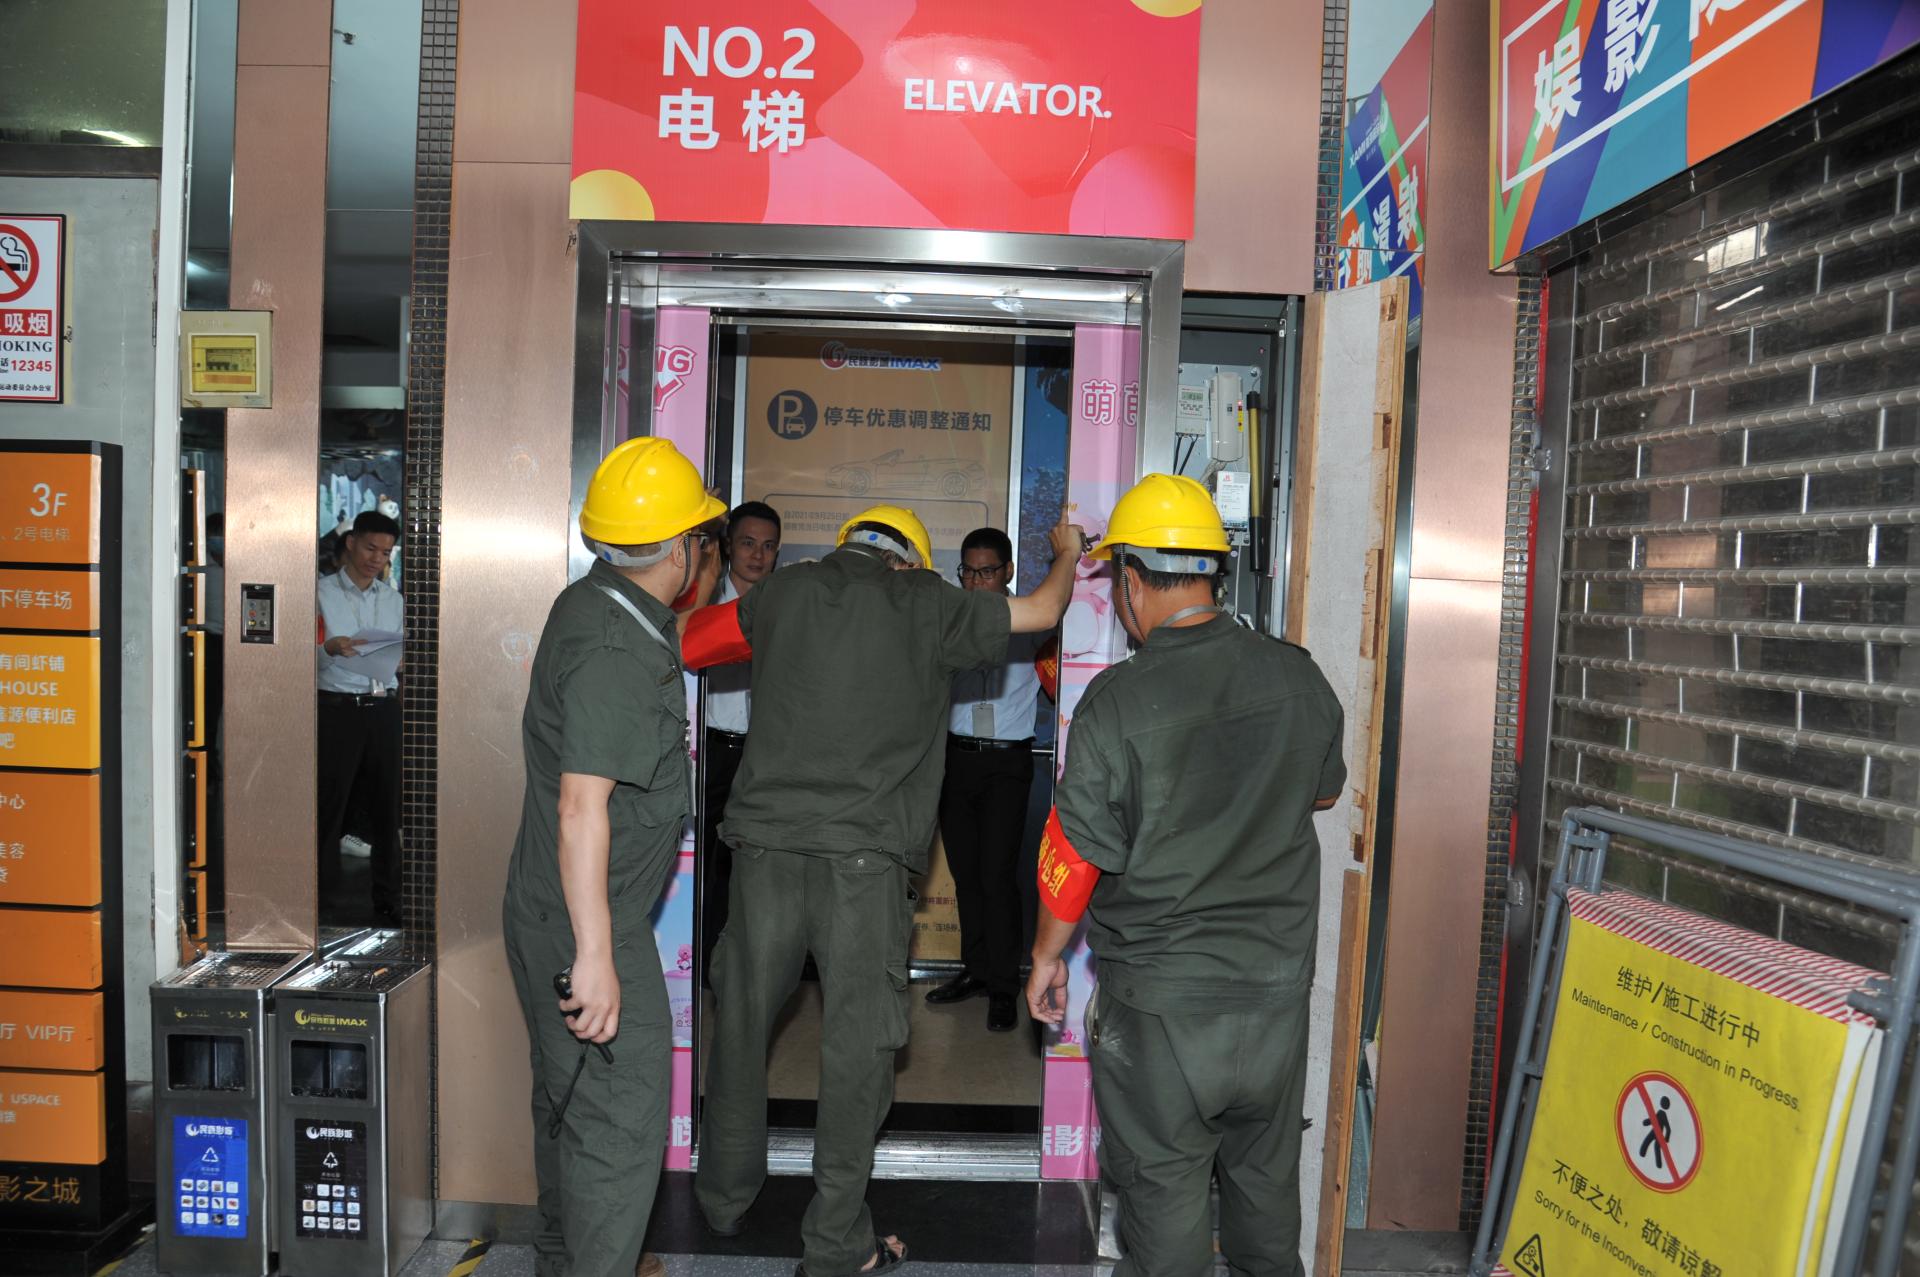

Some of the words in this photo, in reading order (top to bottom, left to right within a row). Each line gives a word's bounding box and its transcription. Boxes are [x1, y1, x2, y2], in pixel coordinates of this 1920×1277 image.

[662, 26, 816, 79] NO.2
[904, 78, 1112, 119] ELEVATOR.
[658, 87, 806, 153] 电梯
[0, 312, 49, 334] 吸烟
[11, 360, 53, 372] 12345
[823, 406, 992, 432] 停车优惠调整通知
[1082, 380, 1117, 425] 萌
[30, 483, 68, 517] 3F
[0, 681, 59, 696] HOUSE
[1616, 966, 1760, 1049] 维护/施工进行中
[24, 1024, 76, 1042] VIP厅
[1572, 987, 1639, 1031] Maintenance
[1651, 1024, 1721, 1071] Construction
[1724, 1060, 1736, 1079] in
[1535, 1190, 1564, 1219] Sorry
[1565, 1210, 1580, 1229] for
[1582, 1222, 1600, 1243] the
